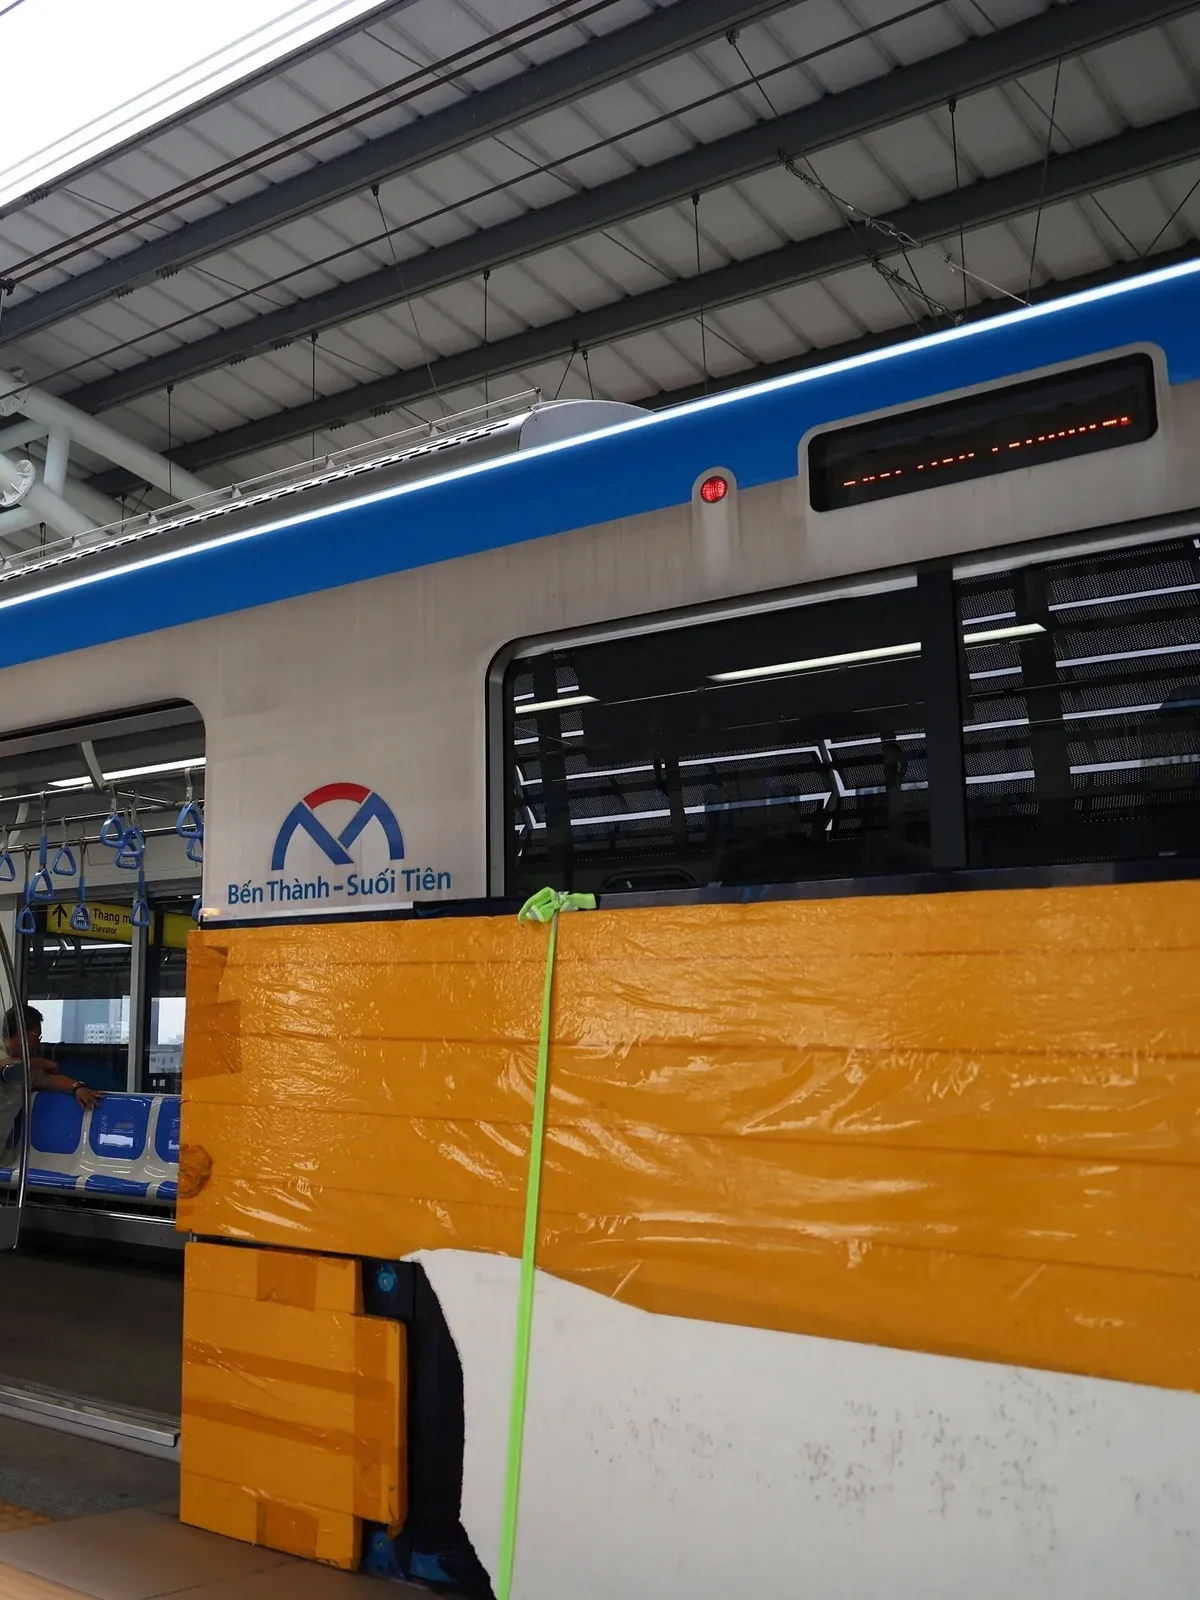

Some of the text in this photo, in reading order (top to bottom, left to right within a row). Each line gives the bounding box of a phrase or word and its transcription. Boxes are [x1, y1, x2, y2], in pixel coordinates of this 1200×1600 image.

[228, 880, 264, 905] Bến
[401, 867, 451, 892] Tiên
[93, 908, 120, 925] Thang
[92, 923, 117, 935] Elevator
